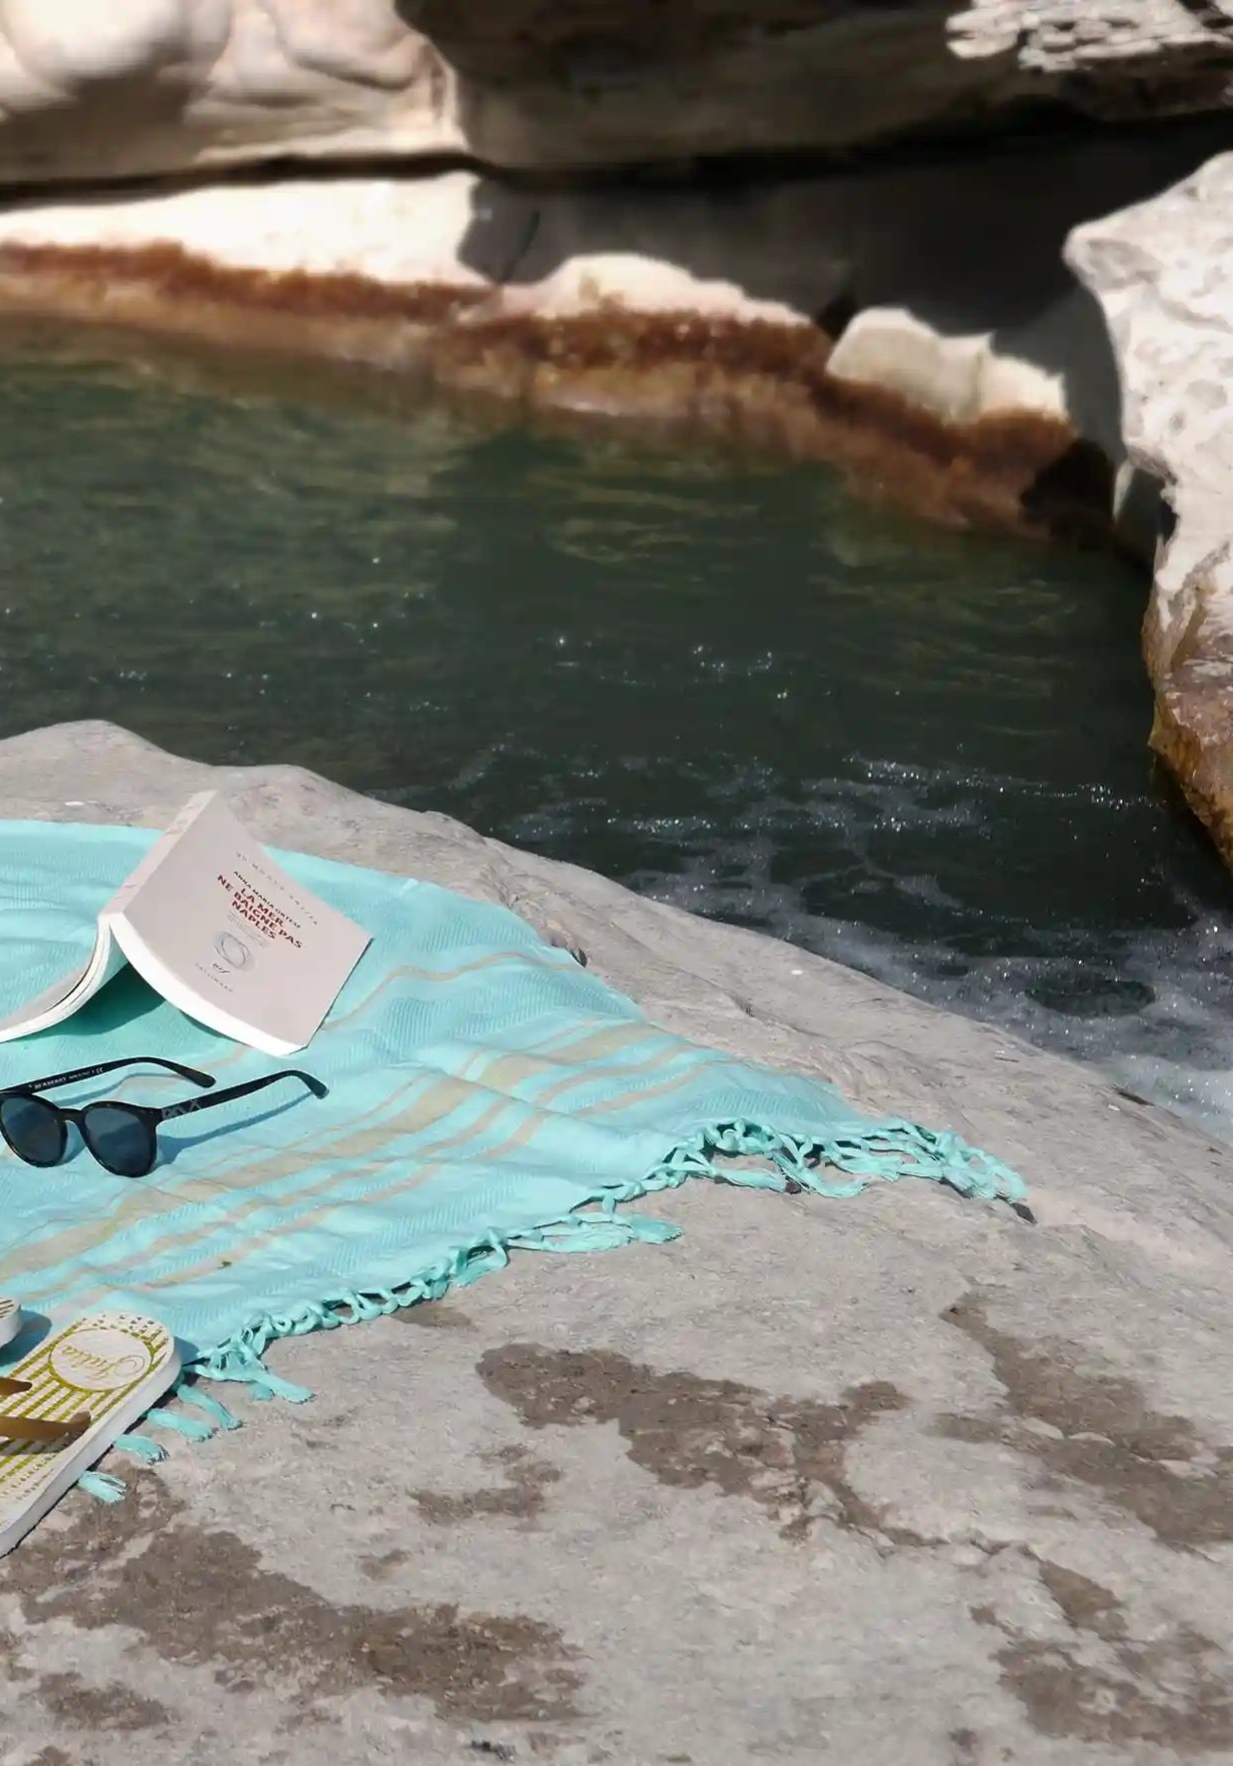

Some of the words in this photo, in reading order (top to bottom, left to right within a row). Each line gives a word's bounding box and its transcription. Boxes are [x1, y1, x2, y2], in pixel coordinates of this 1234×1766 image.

[217, 874, 233, 892] NE
[234, 891, 277, 929] BAIGNE
[279, 930, 302, 949] PAS
[231, 900, 276, 940] NAPLES
[240, 887, 256, 903] LA
[257, 903, 285, 927] MER
